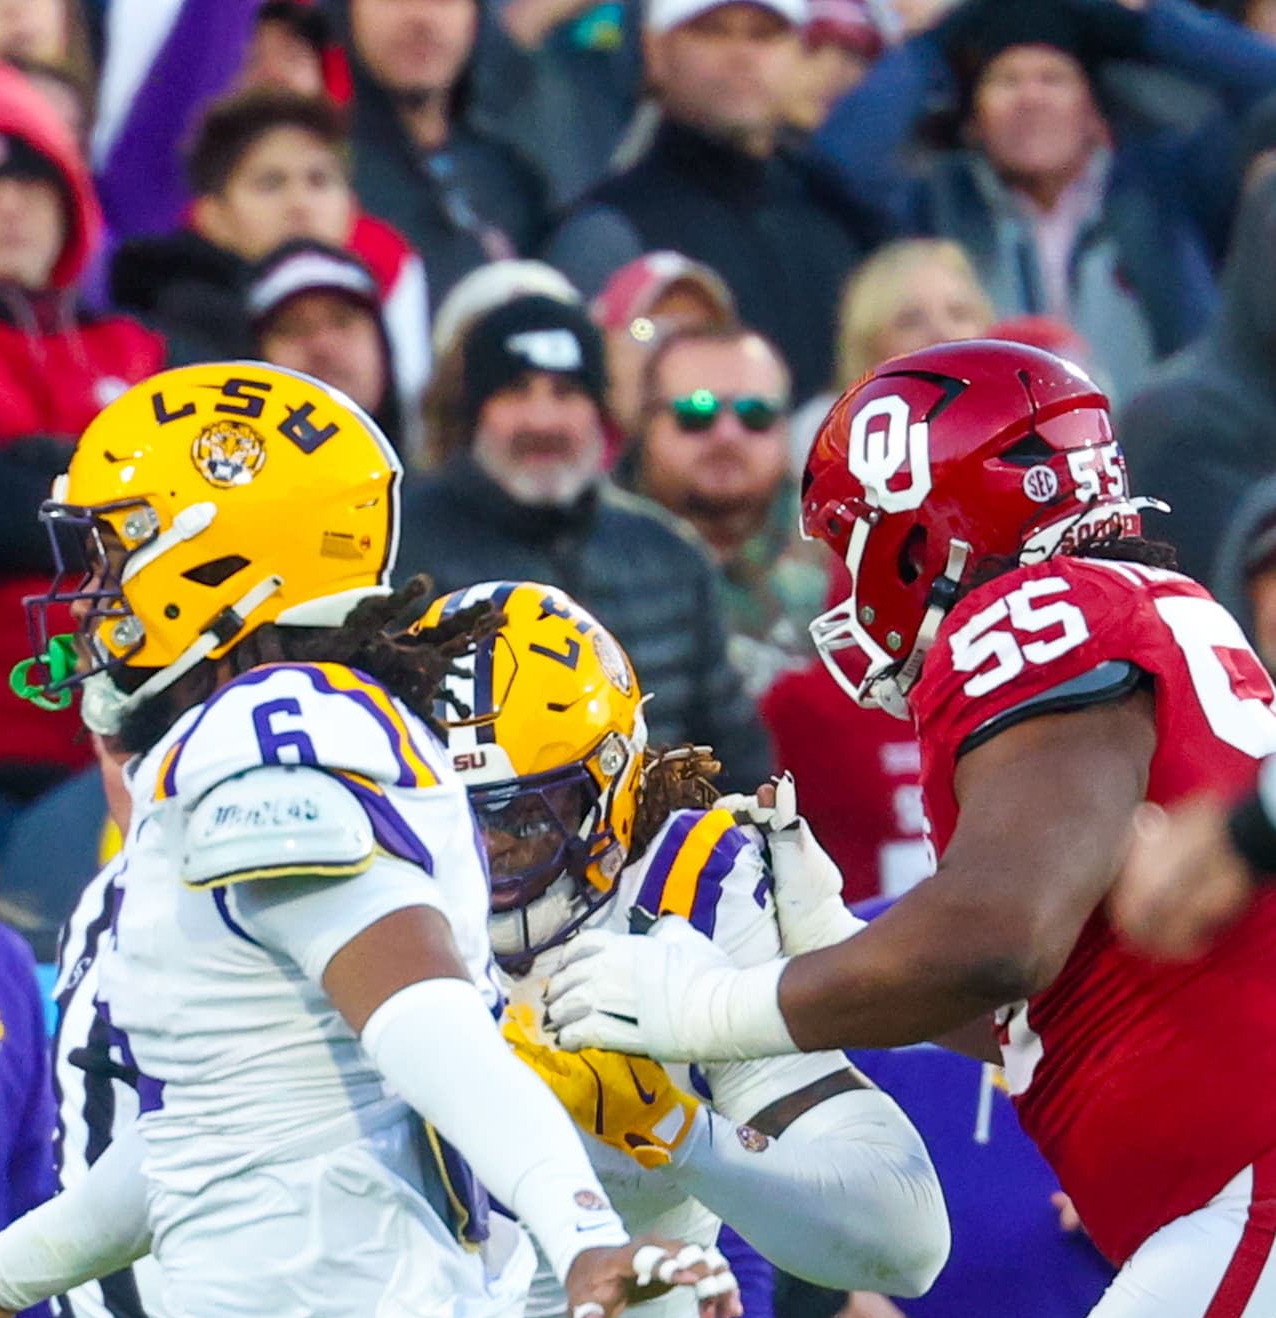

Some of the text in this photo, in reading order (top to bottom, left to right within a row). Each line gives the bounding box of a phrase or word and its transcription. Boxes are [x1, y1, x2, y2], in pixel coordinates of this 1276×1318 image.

[848, 395, 932, 514] OU
[1025, 467, 1056, 500] SEC
[1066, 444, 1124, 503] 55
[949, 576, 1089, 697] 55
[252, 698, 319, 766] 6
[453, 751, 487, 772] SU
